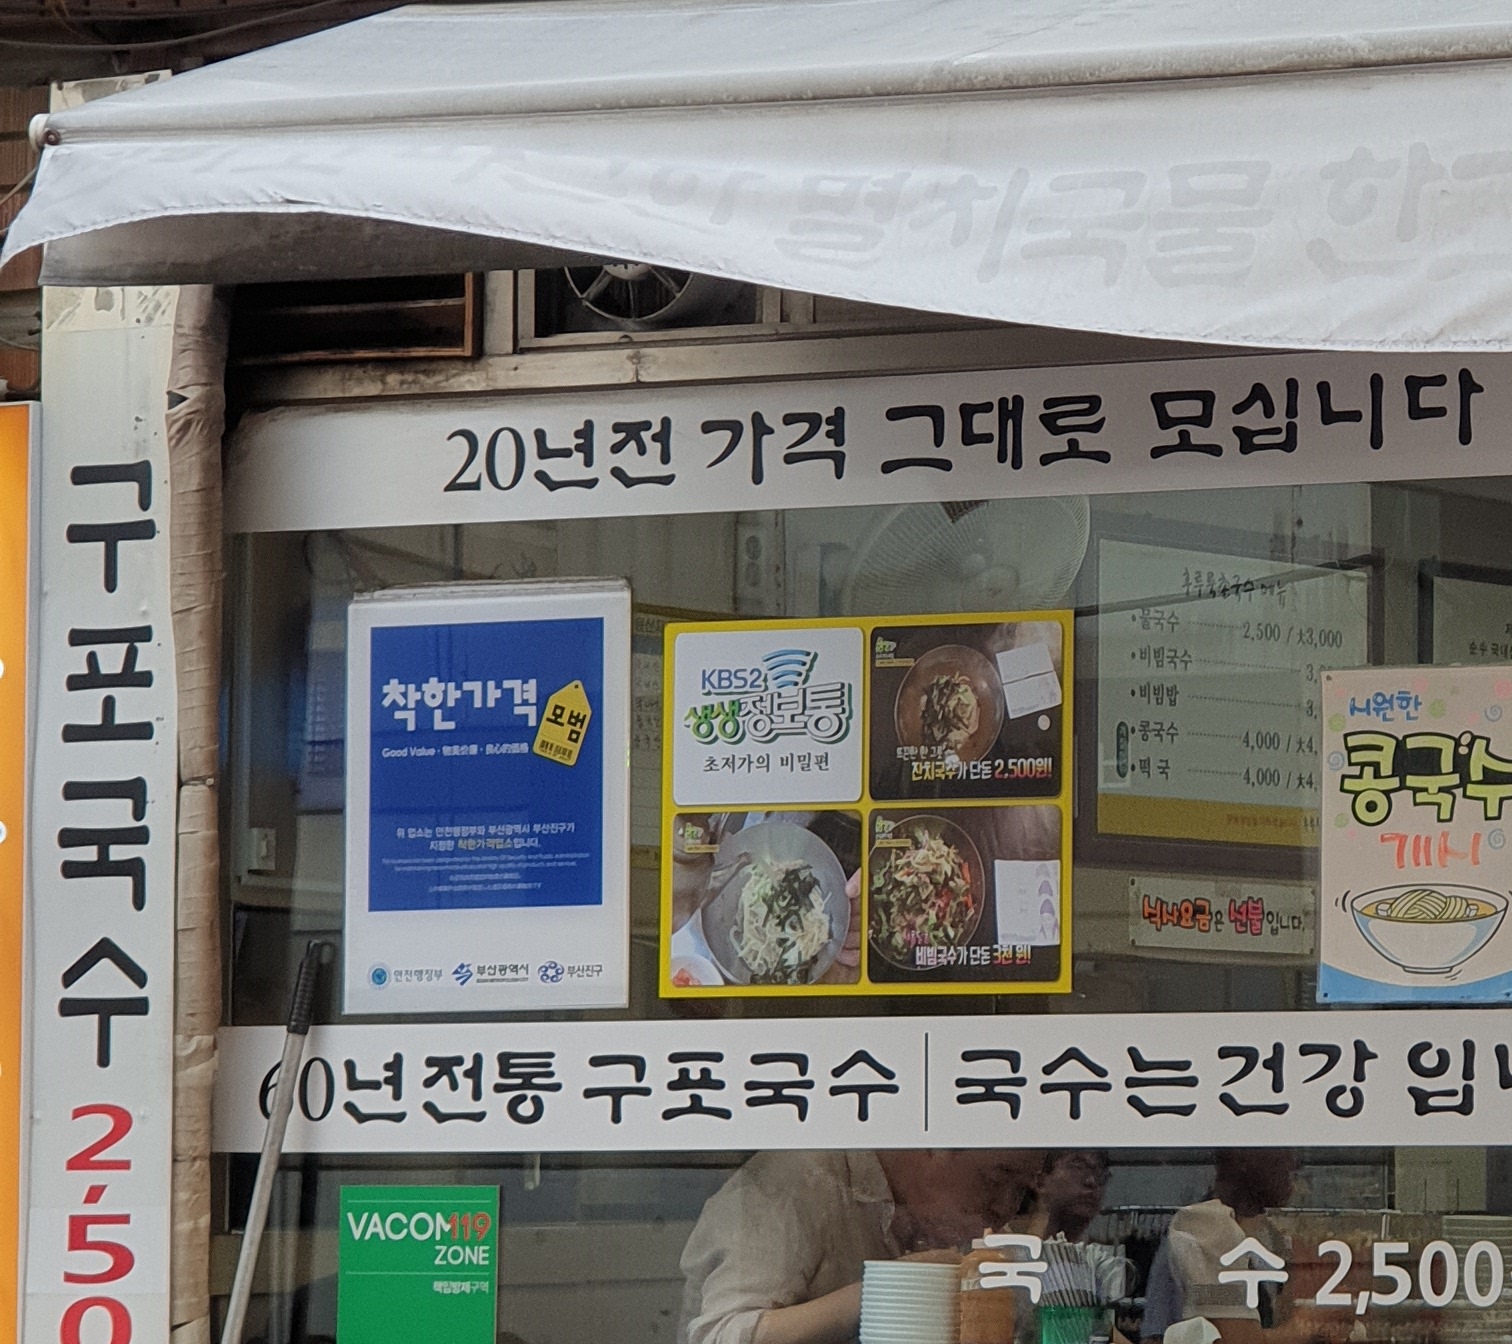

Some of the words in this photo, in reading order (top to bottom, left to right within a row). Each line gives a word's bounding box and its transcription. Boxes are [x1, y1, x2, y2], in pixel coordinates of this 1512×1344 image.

[444, 414, 678, 494] 20년전
[702, 408, 845, 487] 가격
[882, 393, 1110, 474] 그대로
[1150, 367, 1484, 463] 모십니다
[1242, 621, 1281, 644] 2,500
[702, 667, 763, 692] KBS2
[382, 677, 537, 732] 착한가격
[546, 704, 586, 743] 모범
[687, 680, 850, 744] 생생정보통
[1349, 690, 1423, 723] 시원한
[57, 459, 156, 1068] 구포국수
[382, 747, 408, 758] Good
[703, 754, 771, 774] 초저가의
[779, 751, 830, 773] 비밀편
[969, 760, 992, 778] 단돈
[969, 946, 991, 965] 단돈
[476, 963, 529, 976] 부산광역시
[567, 964, 603, 978] 부산진구
[585, 1046, 900, 1126] 구포국수
[954, 1038, 1377, 1122] 국수는건강
[434, 1245, 490, 1266] ZONE
